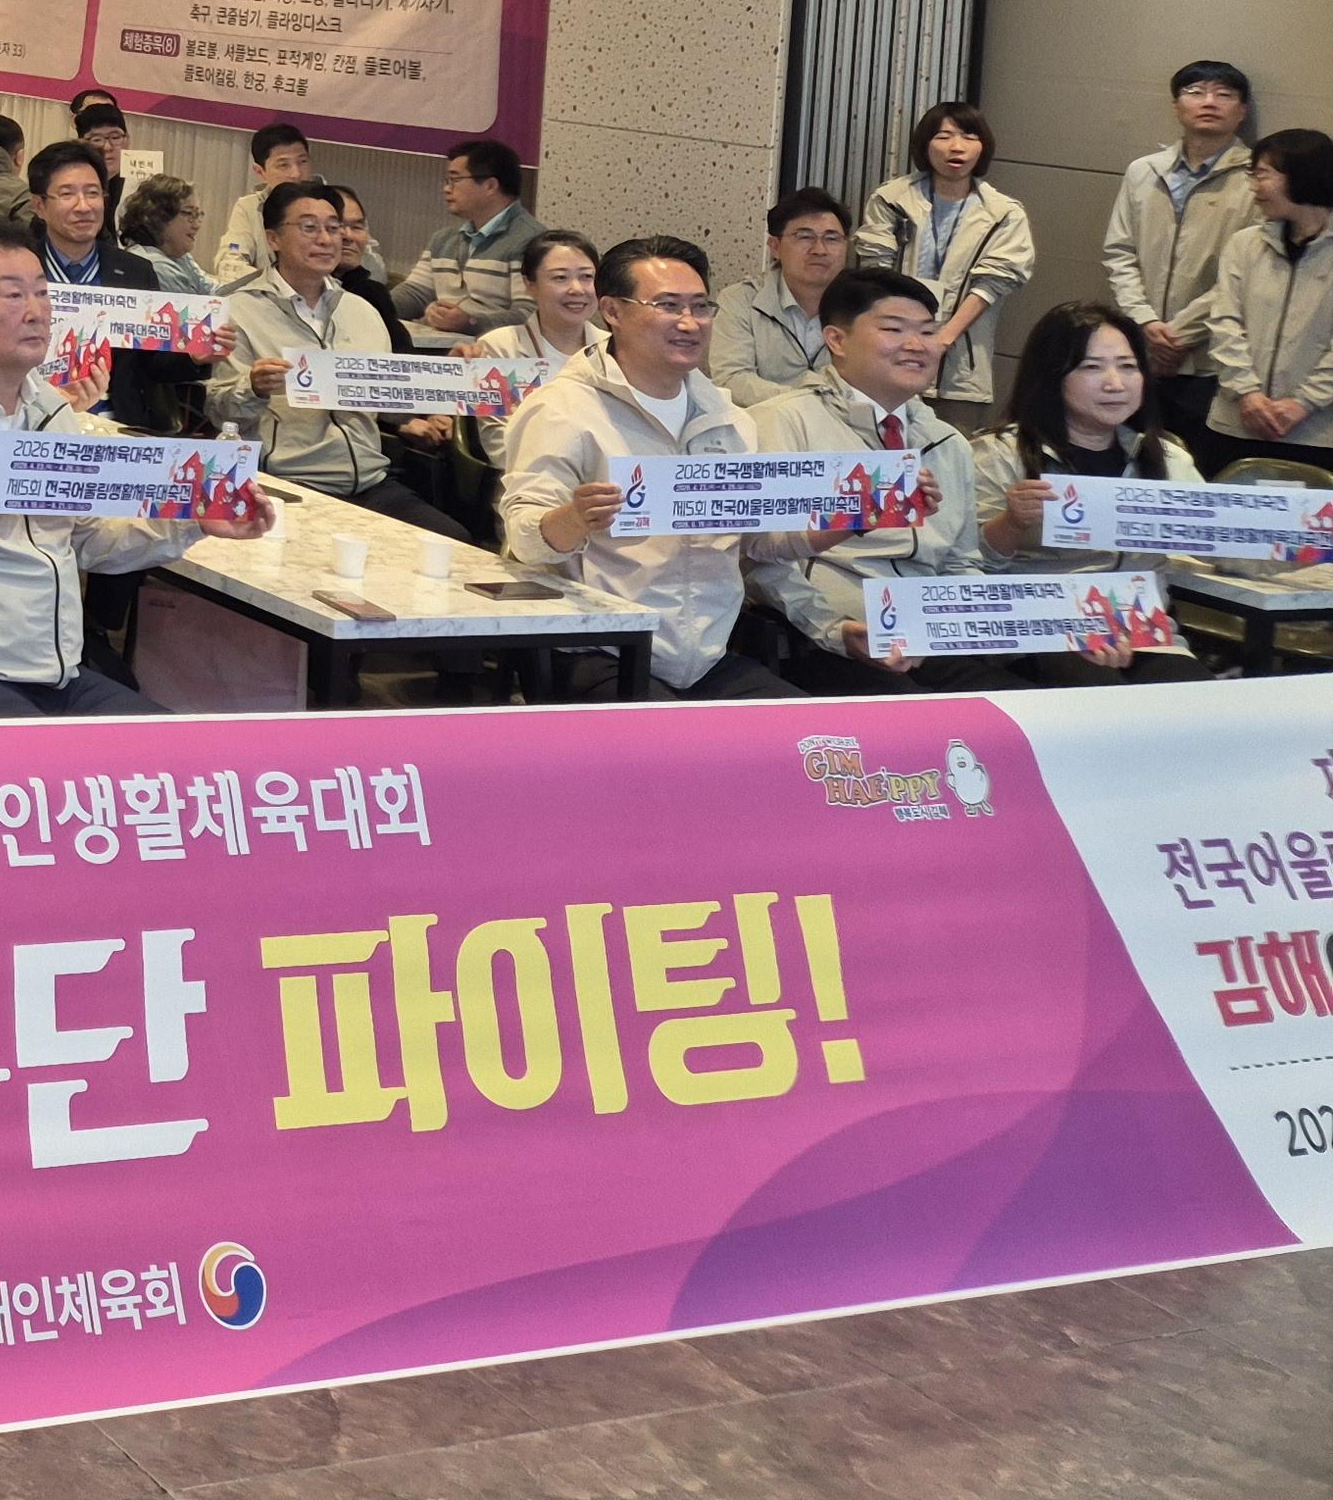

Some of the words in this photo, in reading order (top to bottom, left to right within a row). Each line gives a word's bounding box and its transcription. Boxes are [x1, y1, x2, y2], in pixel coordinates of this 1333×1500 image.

[189, 4, 213, 24] 축구,
[217, 6, 263, 28] 큰줄넘기,
[267, 11, 342, 33] 플라잉디스크
[276, 48, 327, 72] 표적게임,
[364, 57, 427, 81] 플로어볼,
[184, 64, 239, 89] 플로어컬링,
[244, 70, 269, 91] 한궁,
[273, 74, 309, 97] 후크볼
[13, 440, 50, 459] 2026
[53, 441, 165, 465] 전국생활체육대축전
[674, 463, 711, 480] 2026
[713, 460, 826, 480] 전국생활체육대축전
[6, 478, 42, 496] 제5회
[45, 480, 192, 502] 전국어울림생활체육대축전
[673, 499, 707, 517] 제5회
[711, 495, 861, 517] 전국어울림생활체육대축전
[921, 585, 958, 601] 2026
[805, 748, 864, 780] GIM
[1155, 831, 1333, 910] 전국어울
[1195, 930, 1333, 1028] 김해
[259, 891, 867, 1132] 파이팅!
